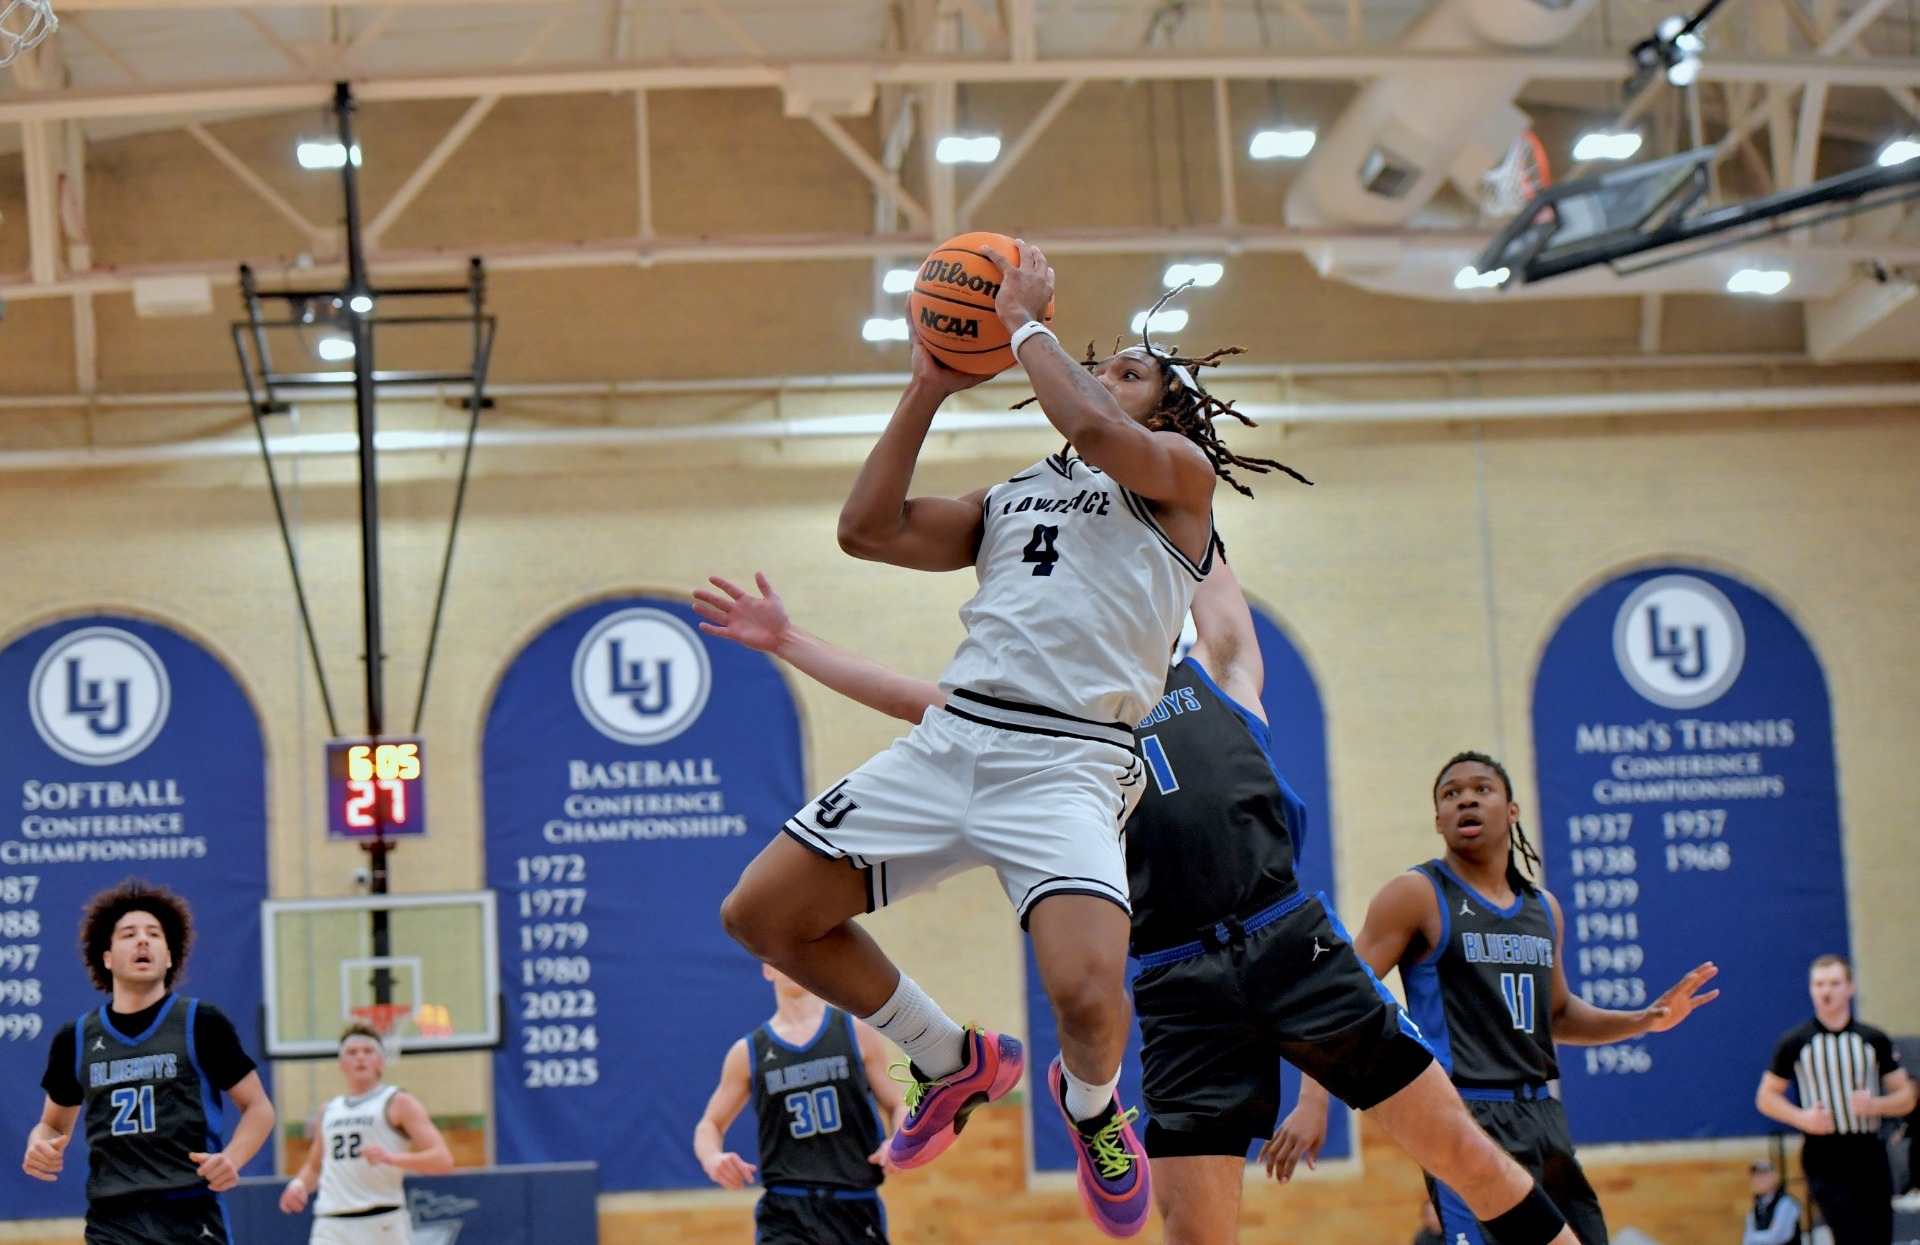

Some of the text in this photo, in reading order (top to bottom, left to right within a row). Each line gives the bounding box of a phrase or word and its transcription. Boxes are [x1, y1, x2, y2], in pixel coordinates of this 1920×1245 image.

[922, 259, 1001, 299] Wilson
[921, 306, 979, 338] NCAA
[1022, 523, 1059, 576] 4
[1646, 605, 1707, 680] LU
[608, 639, 672, 716] LU
[66, 658, 130, 736] LU
[1674, 718, 1795, 749] TENNIS
[569, 758, 721, 790] BASEBALL
[22, 778, 185, 811] SOFTBALL
[346, 779, 406, 827] 27
[564, 791, 724, 820] CONFERENCE
[21, 812, 184, 840] CONFERENCE
[543, 814, 747, 845] CHAMPIONSHIPS
[0, 835, 208, 866] CHAMPIONSHIPS
[517, 853, 586, 885] 1972
[0, 875, 40, 905] 87
[518, 888, 588, 919] 1977
[0, 909, 41, 939] 88
[520, 922, 590, 953] 1979
[1461, 932, 1553, 968] BLUEBOYS
[521, 956, 591, 987] 1980
[521, 989, 597, 1021] 2022
[1500, 972, 1535, 1034] 11
[521, 1024, 599, 1055] 2024
[89, 1053, 178, 1088] BLUEBOYS
[523, 1057, 600, 1089] 2025
[111, 1085, 156, 1137] 21
[784, 1085, 843, 1140] 30
[333, 1132, 362, 1161] 22
